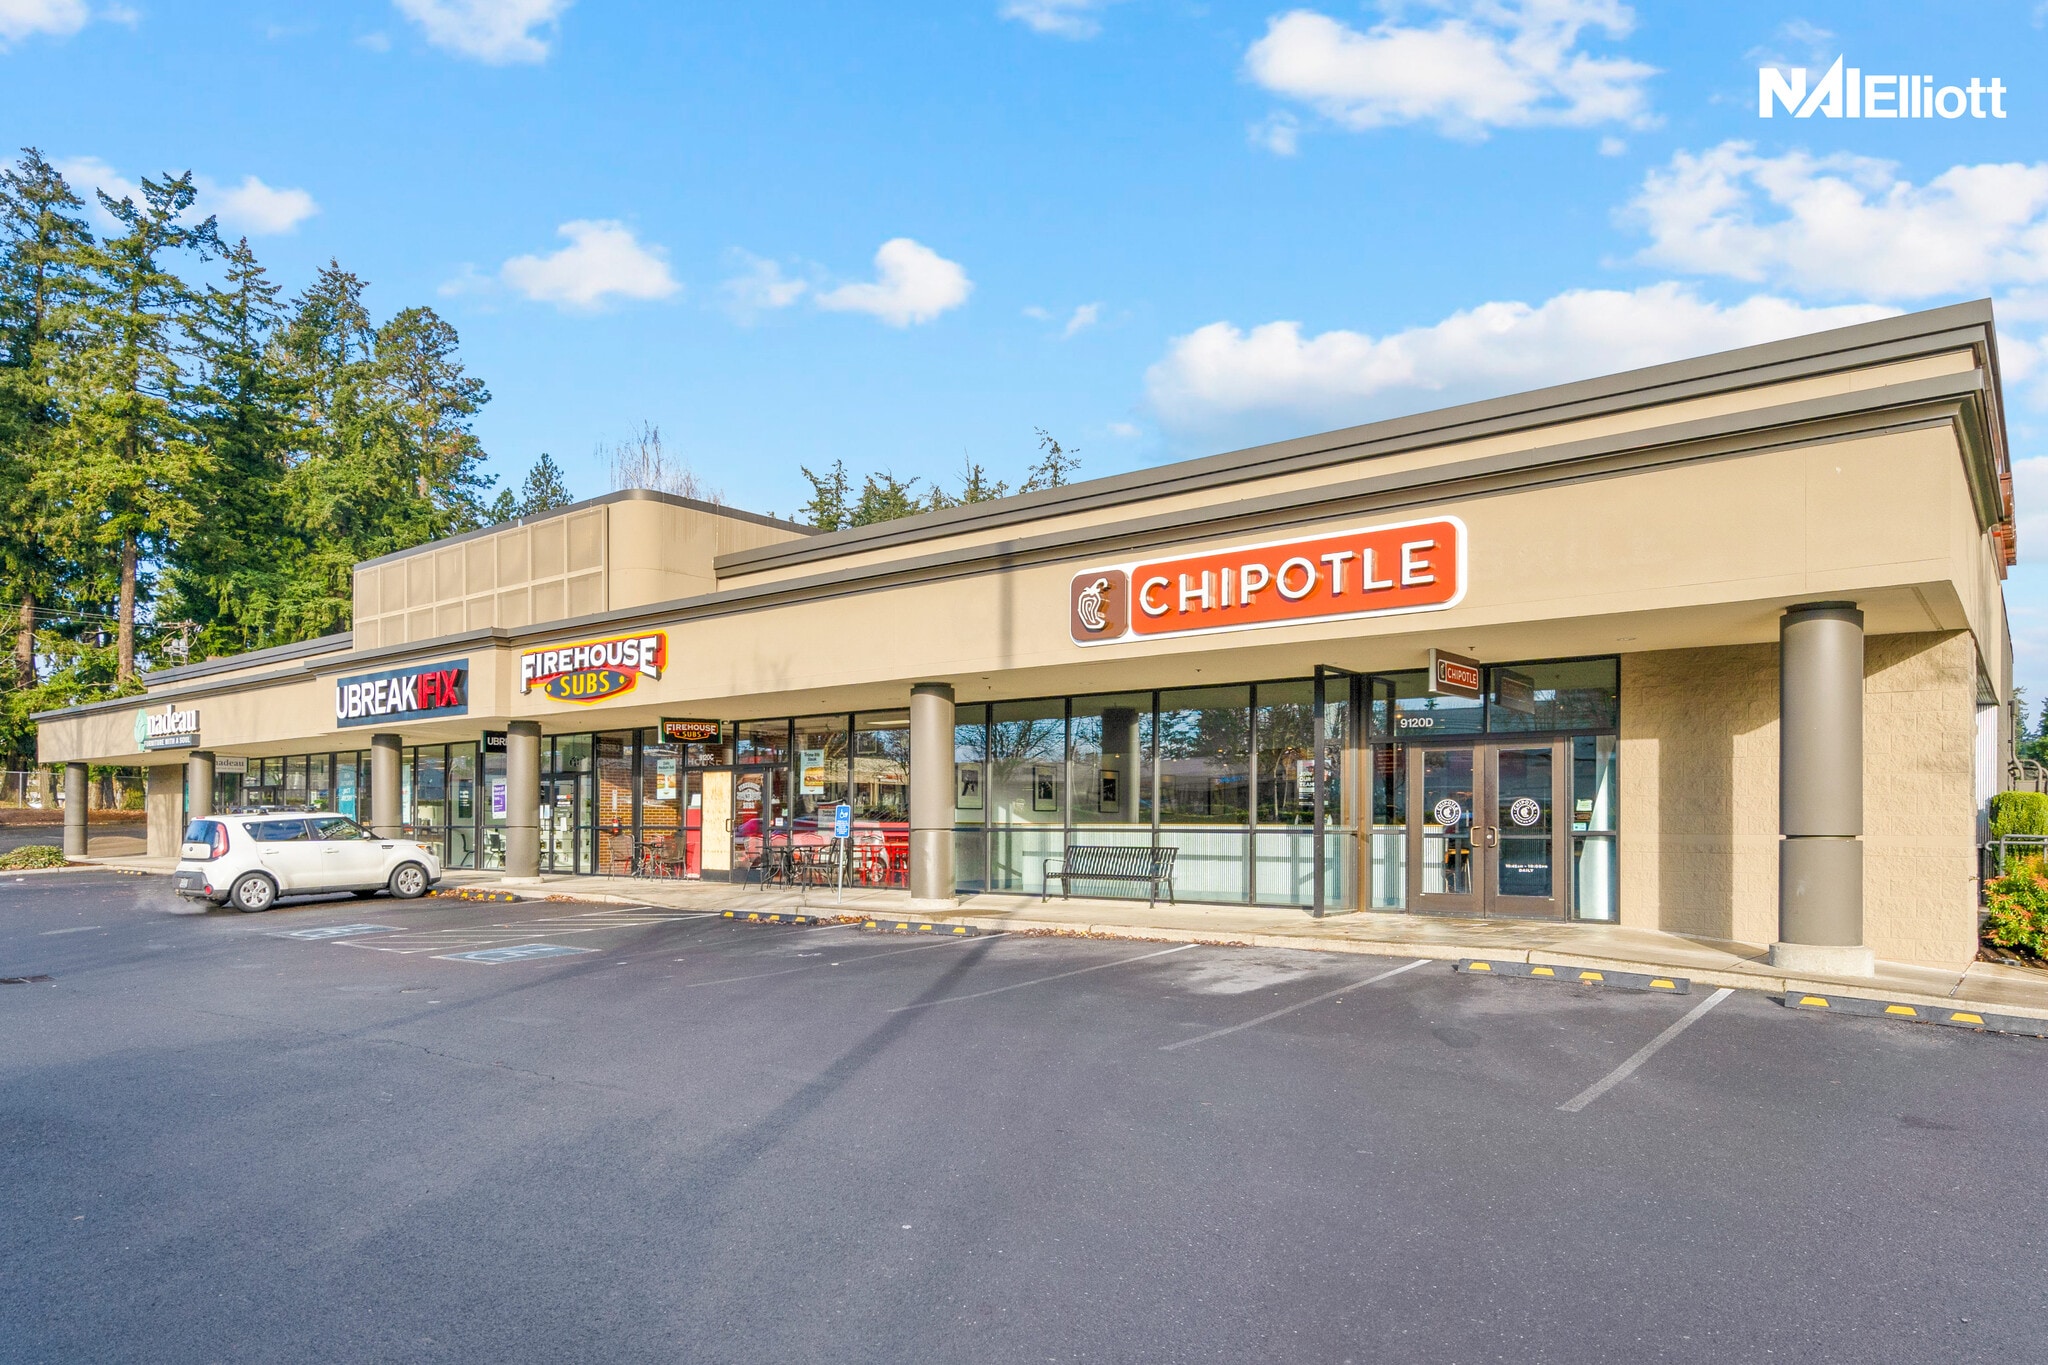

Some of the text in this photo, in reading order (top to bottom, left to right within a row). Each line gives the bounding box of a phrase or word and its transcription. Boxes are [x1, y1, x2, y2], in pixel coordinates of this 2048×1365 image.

[1139, 539, 1438, 617] CHIPOTLE
[520, 635, 659, 694] FIREHOUSE
[1447, 667, 1478, 685] CHIPOTLE
[335, 669, 461, 719] UBREAKIFIX
[559, 670, 610, 697] SUBS
[146, 704, 199, 735] nadeau
[666, 723, 717, 735] FIREHOUSE
[1400, 717, 1434, 729] 9120D
